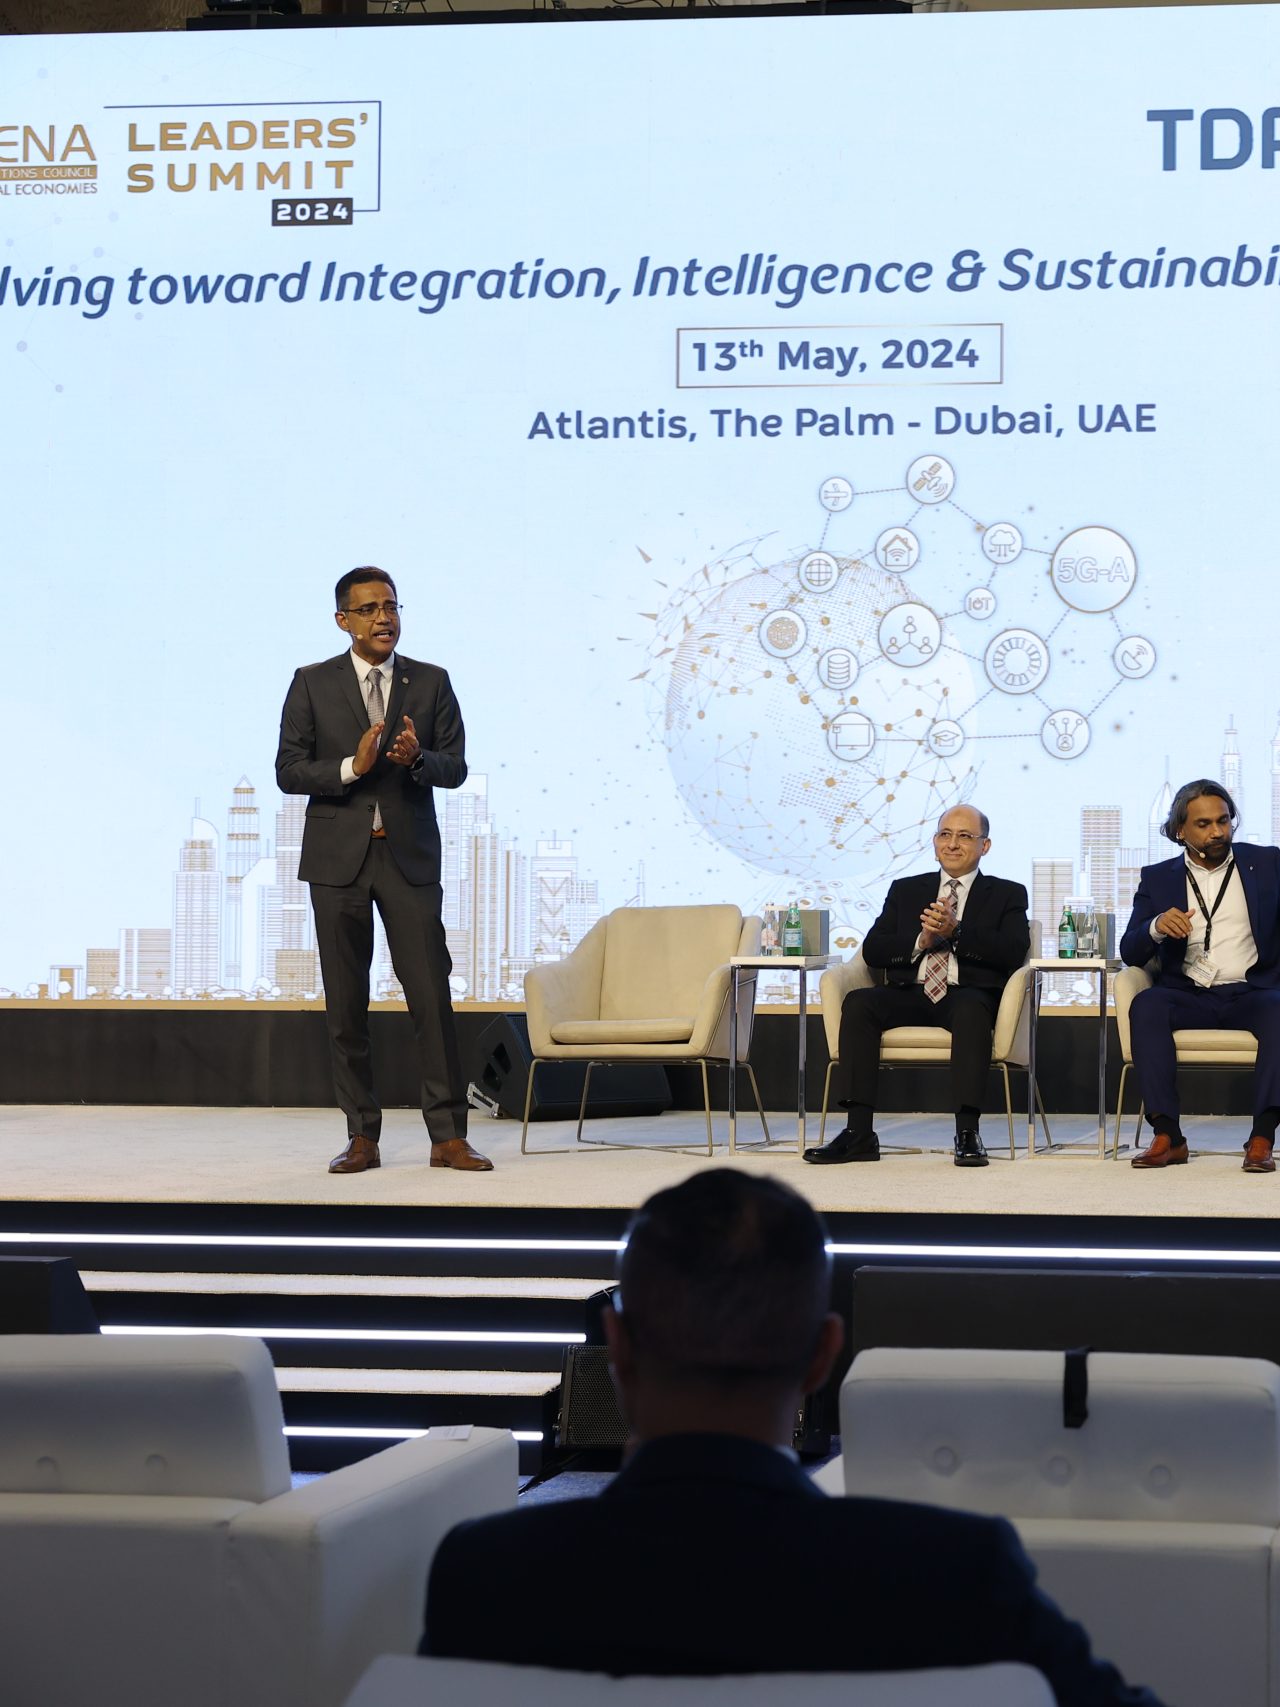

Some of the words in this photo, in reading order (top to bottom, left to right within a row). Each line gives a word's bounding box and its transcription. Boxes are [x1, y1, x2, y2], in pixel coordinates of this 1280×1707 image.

[128, 113, 368, 152] LEADERS'
[43, 167, 93, 177] COUNCIL
[127, 160, 354, 193] SUMMIT
[15, 183, 97, 195] ECONOMIES
[276, 203, 349, 221] 2024
[129, 261, 311, 305] toward
[320, 258, 621, 315] Integration,
[633, 253, 933, 309] Intelligence
[946, 249, 986, 293] &
[778, 341, 867, 377] May,
[881, 338, 979, 369] 2024
[527, 409, 697, 442] Atlantis,
[710, 408, 783, 437] The
[796, 407, 894, 437] Palm
[935, 403, 1064, 438] Dubai,
[1079, 403, 1156, 434] UAE
[1058, 556, 1129, 583] 5G-A
